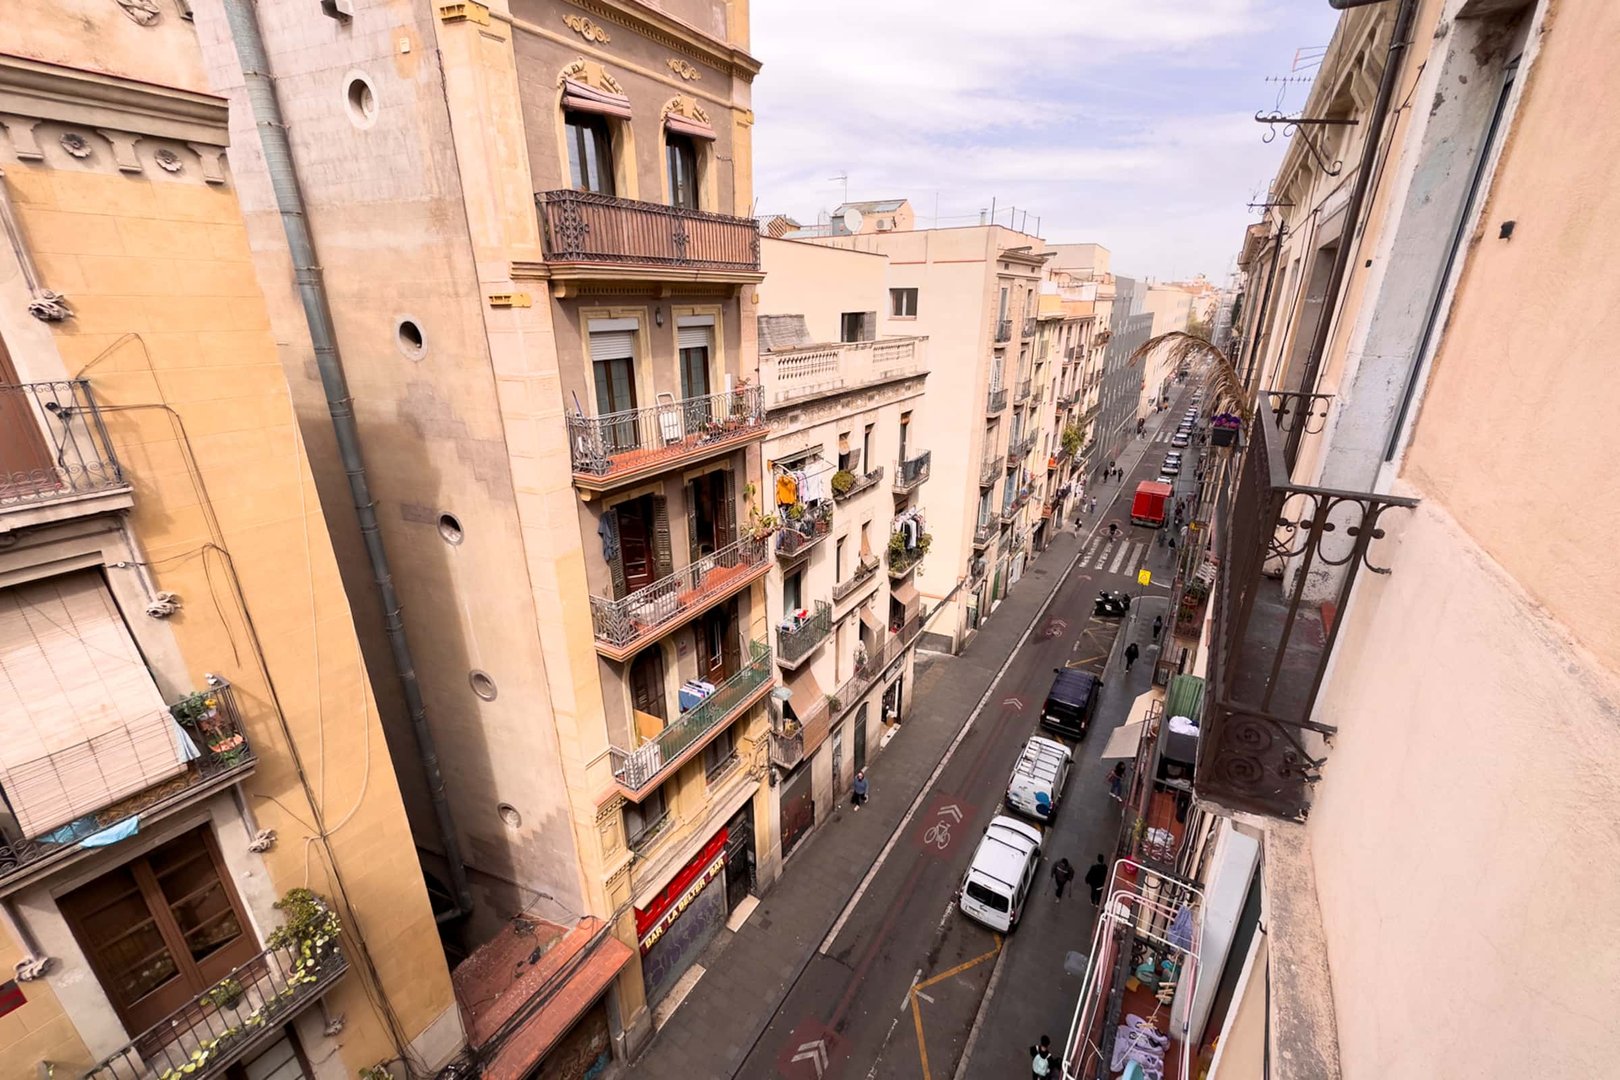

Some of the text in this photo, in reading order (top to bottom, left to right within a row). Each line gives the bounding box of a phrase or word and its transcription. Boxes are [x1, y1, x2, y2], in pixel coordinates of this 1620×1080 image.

[645, 927, 663, 949] BAR
[667, 909, 679, 924] LA
[709, 858, 724, 877] BAR
